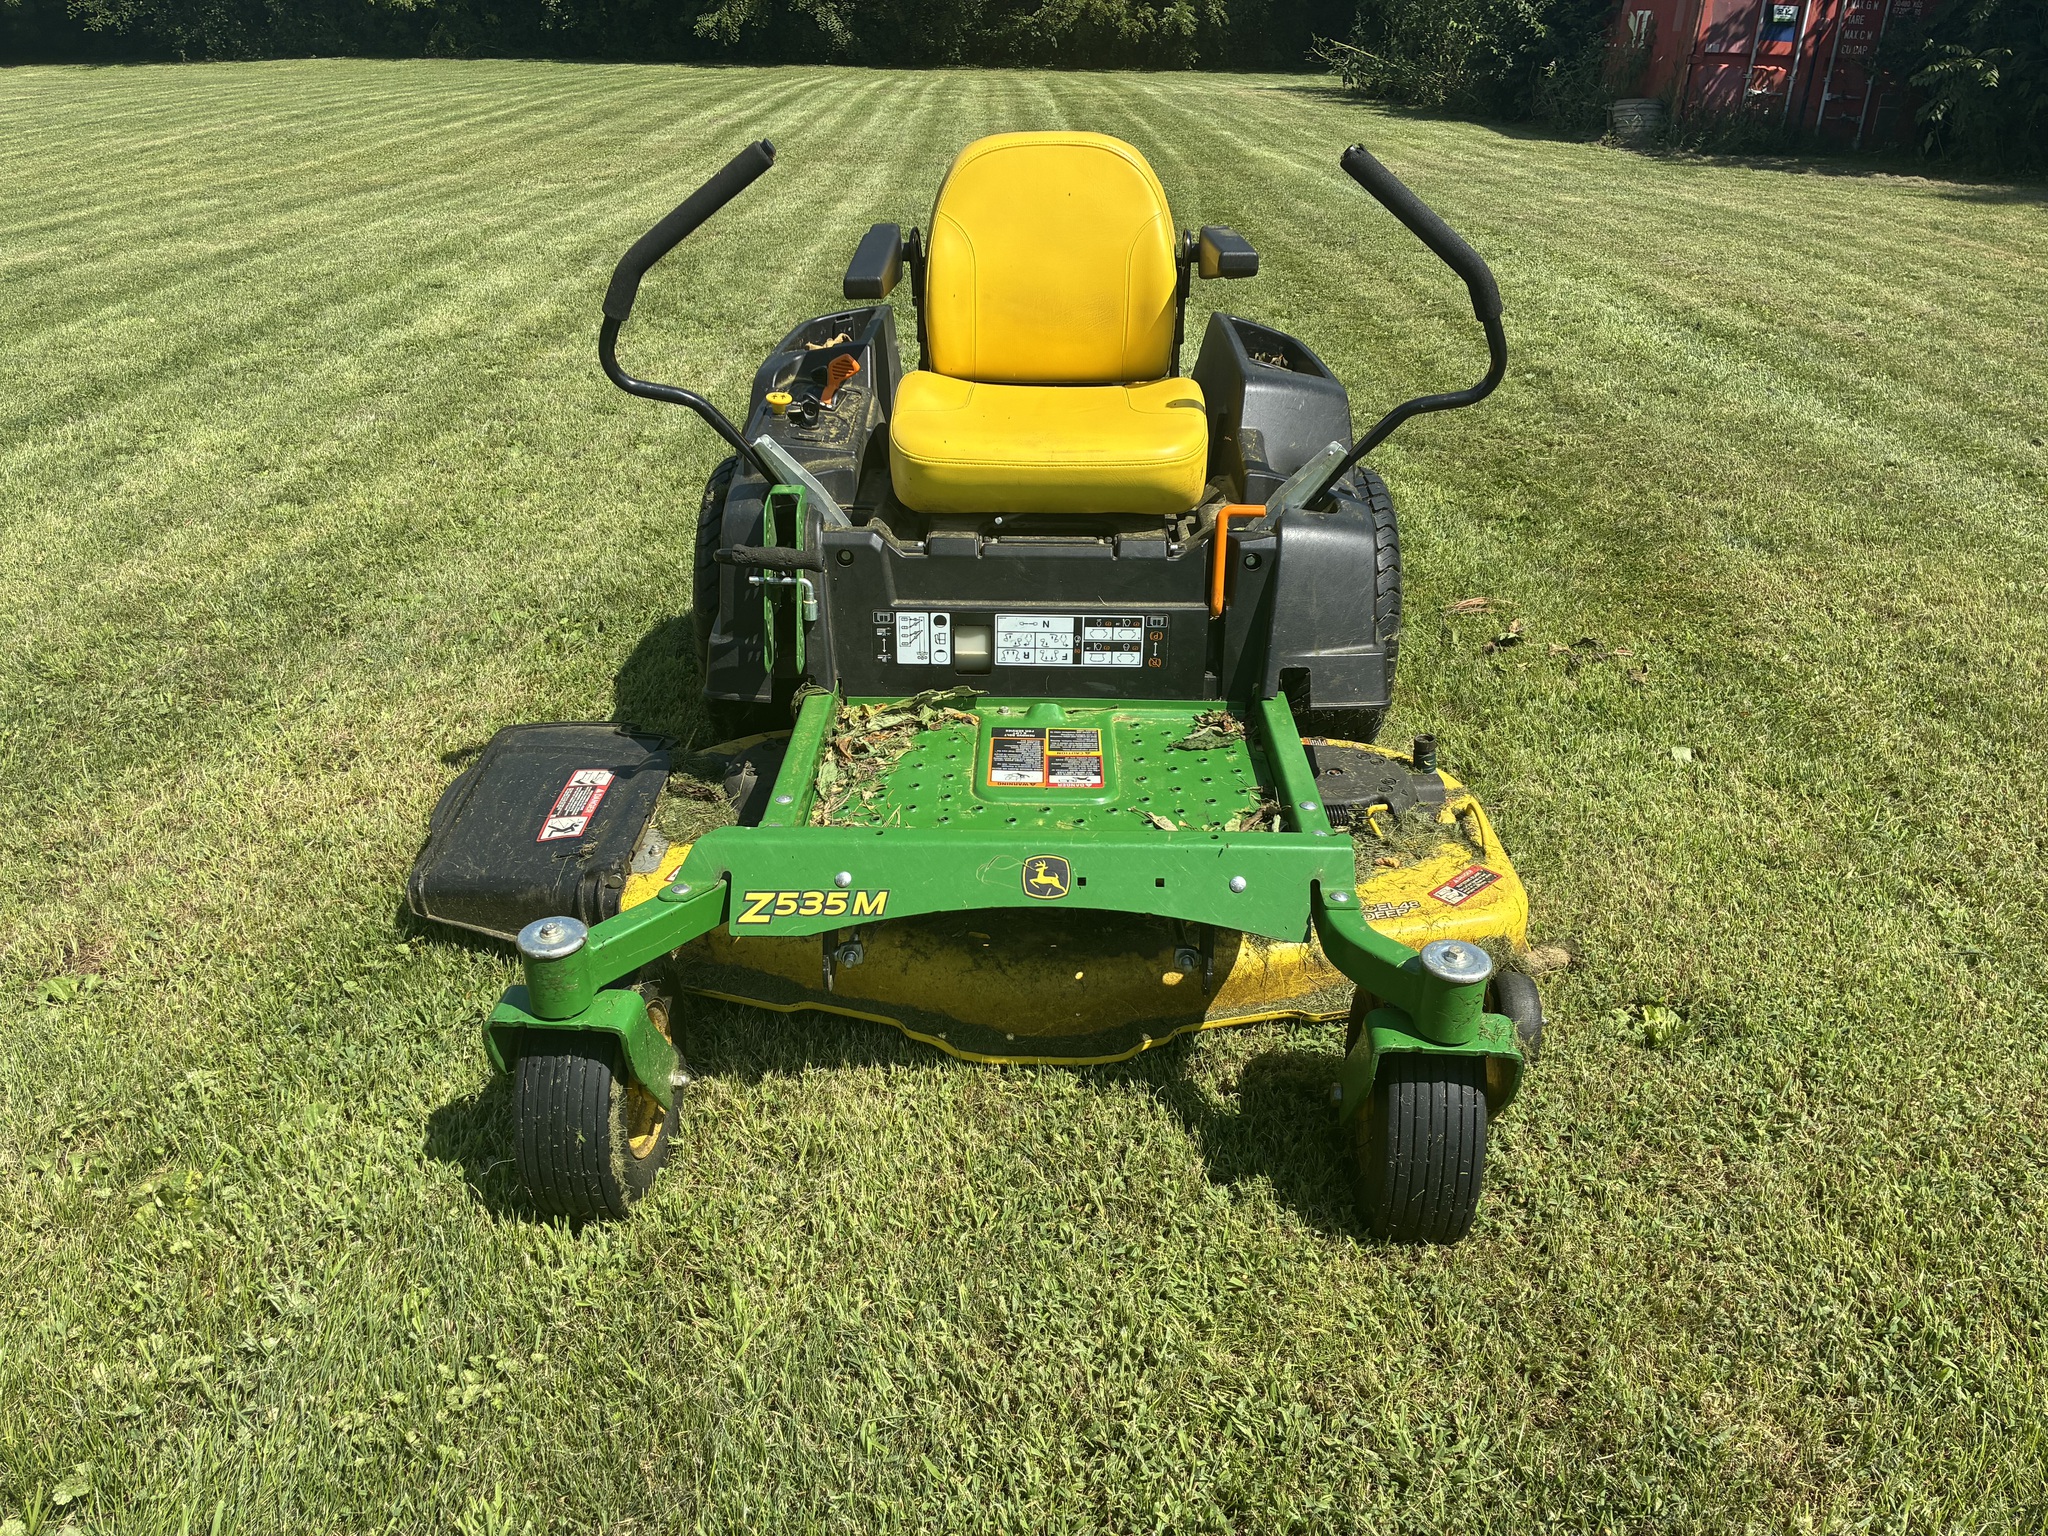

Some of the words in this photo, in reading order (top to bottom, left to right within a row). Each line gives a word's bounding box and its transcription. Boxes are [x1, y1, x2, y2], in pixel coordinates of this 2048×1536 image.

[1848, 14, 1865, 24] TARE
[1844, 30, 1859, 40] MAX
[1042, 620, 1050, 629] N
[1023, 651, 1030, 659] R
[1061, 652, 1068, 660] F
